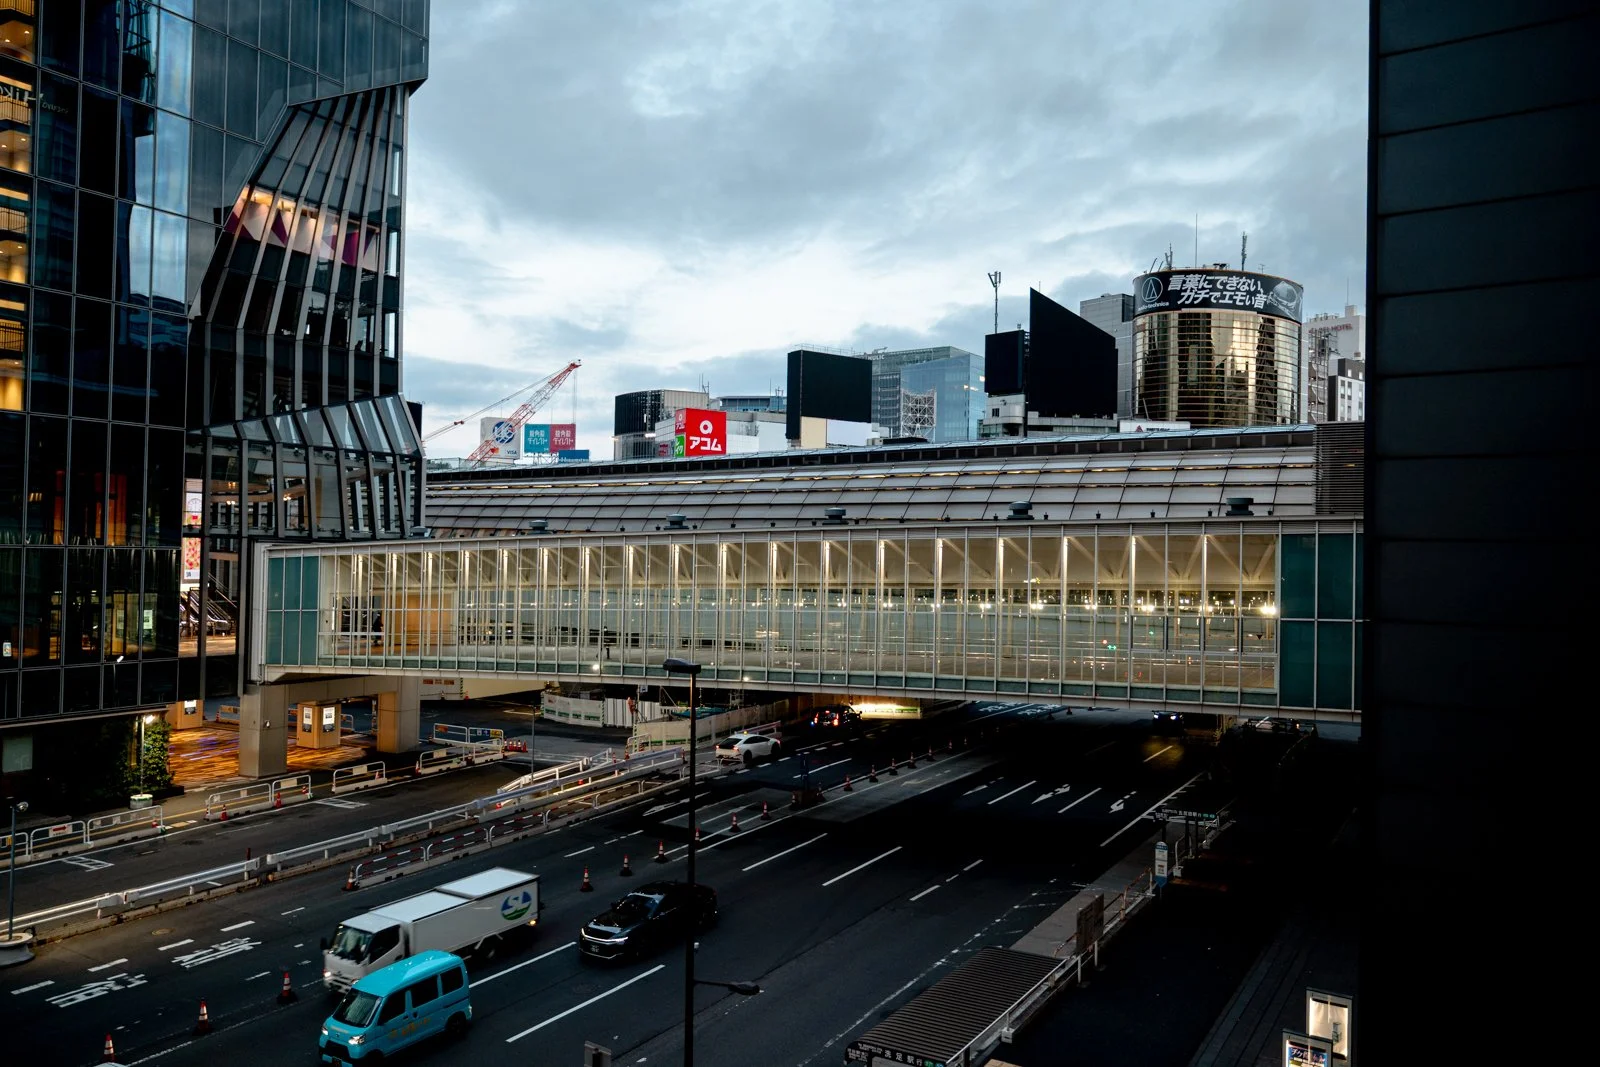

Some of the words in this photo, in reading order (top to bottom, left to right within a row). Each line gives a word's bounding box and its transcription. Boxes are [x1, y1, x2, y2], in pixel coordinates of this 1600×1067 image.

[1167, 274, 1264, 295] 言葉にできない、
[1177, 290, 1267, 308] ガチでエモい音
[689, 436, 722, 451] アコム
